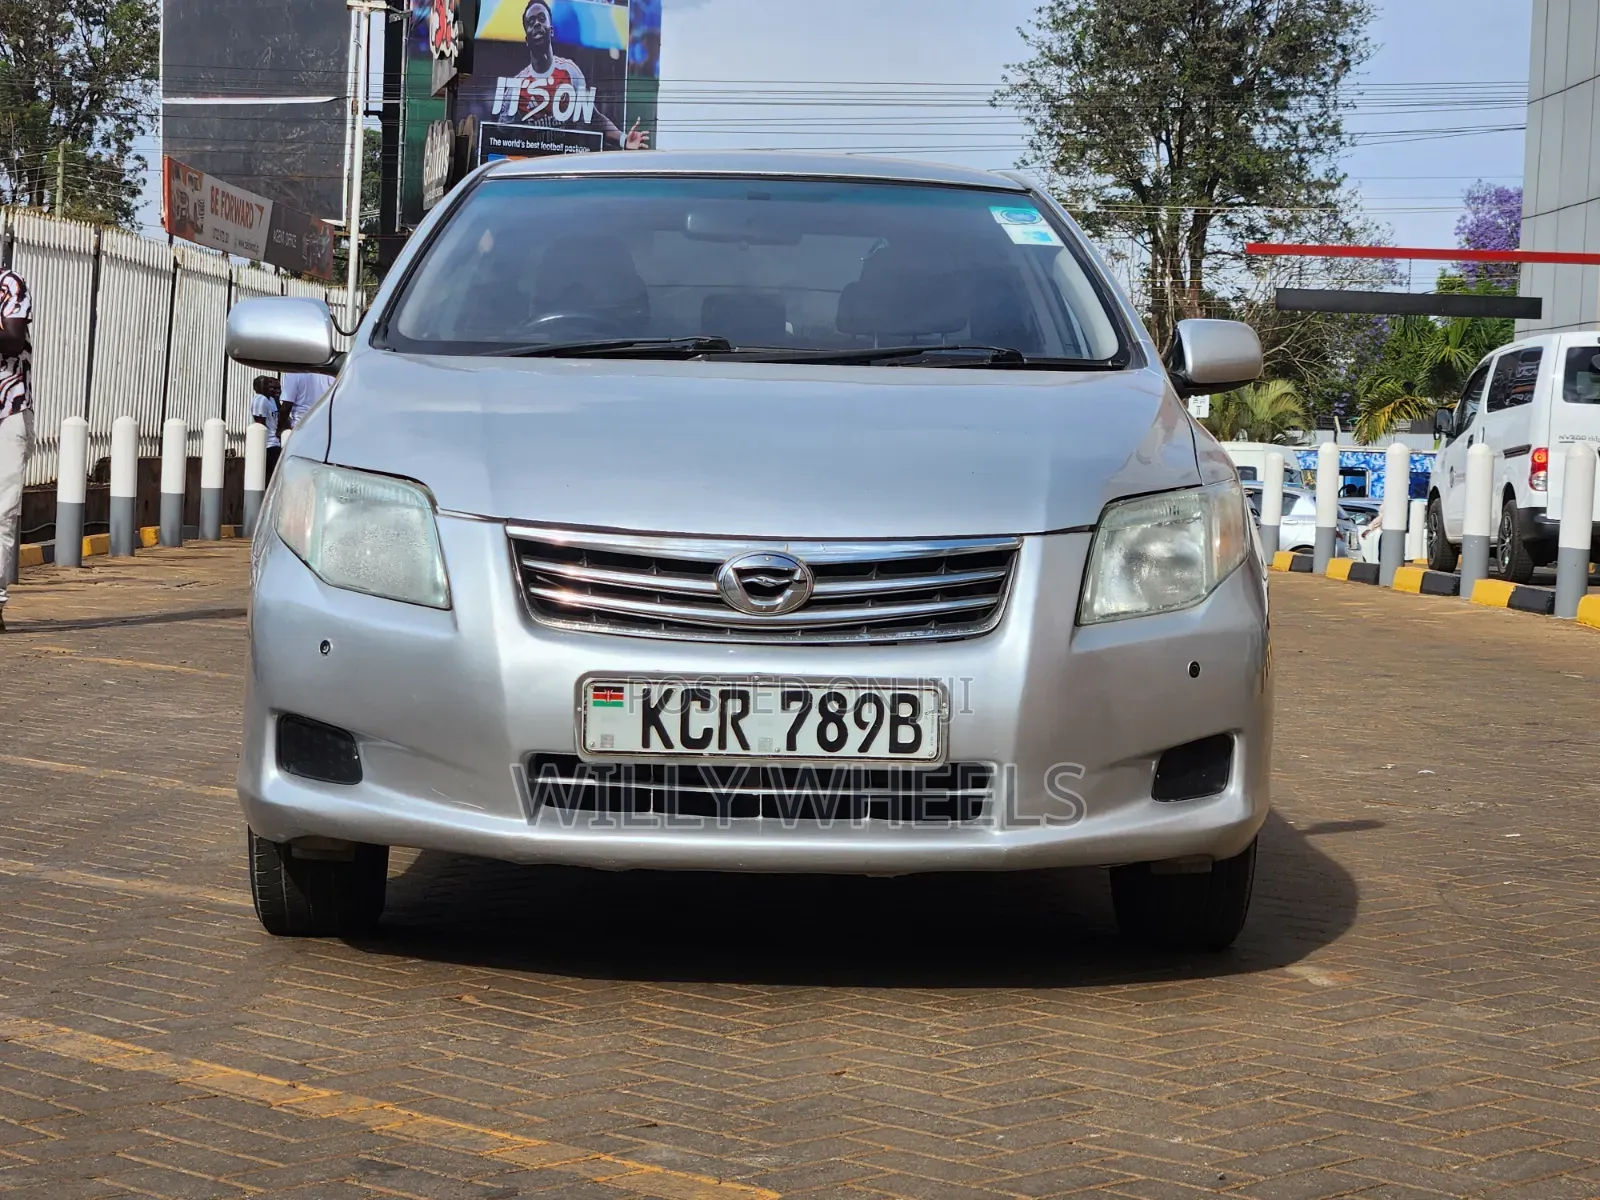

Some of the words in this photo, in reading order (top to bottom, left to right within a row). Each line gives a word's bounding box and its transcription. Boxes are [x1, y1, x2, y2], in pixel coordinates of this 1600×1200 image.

[552, 84, 597, 123] ON
[489, 138, 501, 147] The
[503, 139, 526, 148] world's
[526, 141, 540, 149] best
[541, 142, 564, 152] football
[210, 185, 219, 216] BE
[221, 190, 254, 229] FORWARD
[641, 687, 750, 751] KCR
[781, 690, 923, 754] 789B
